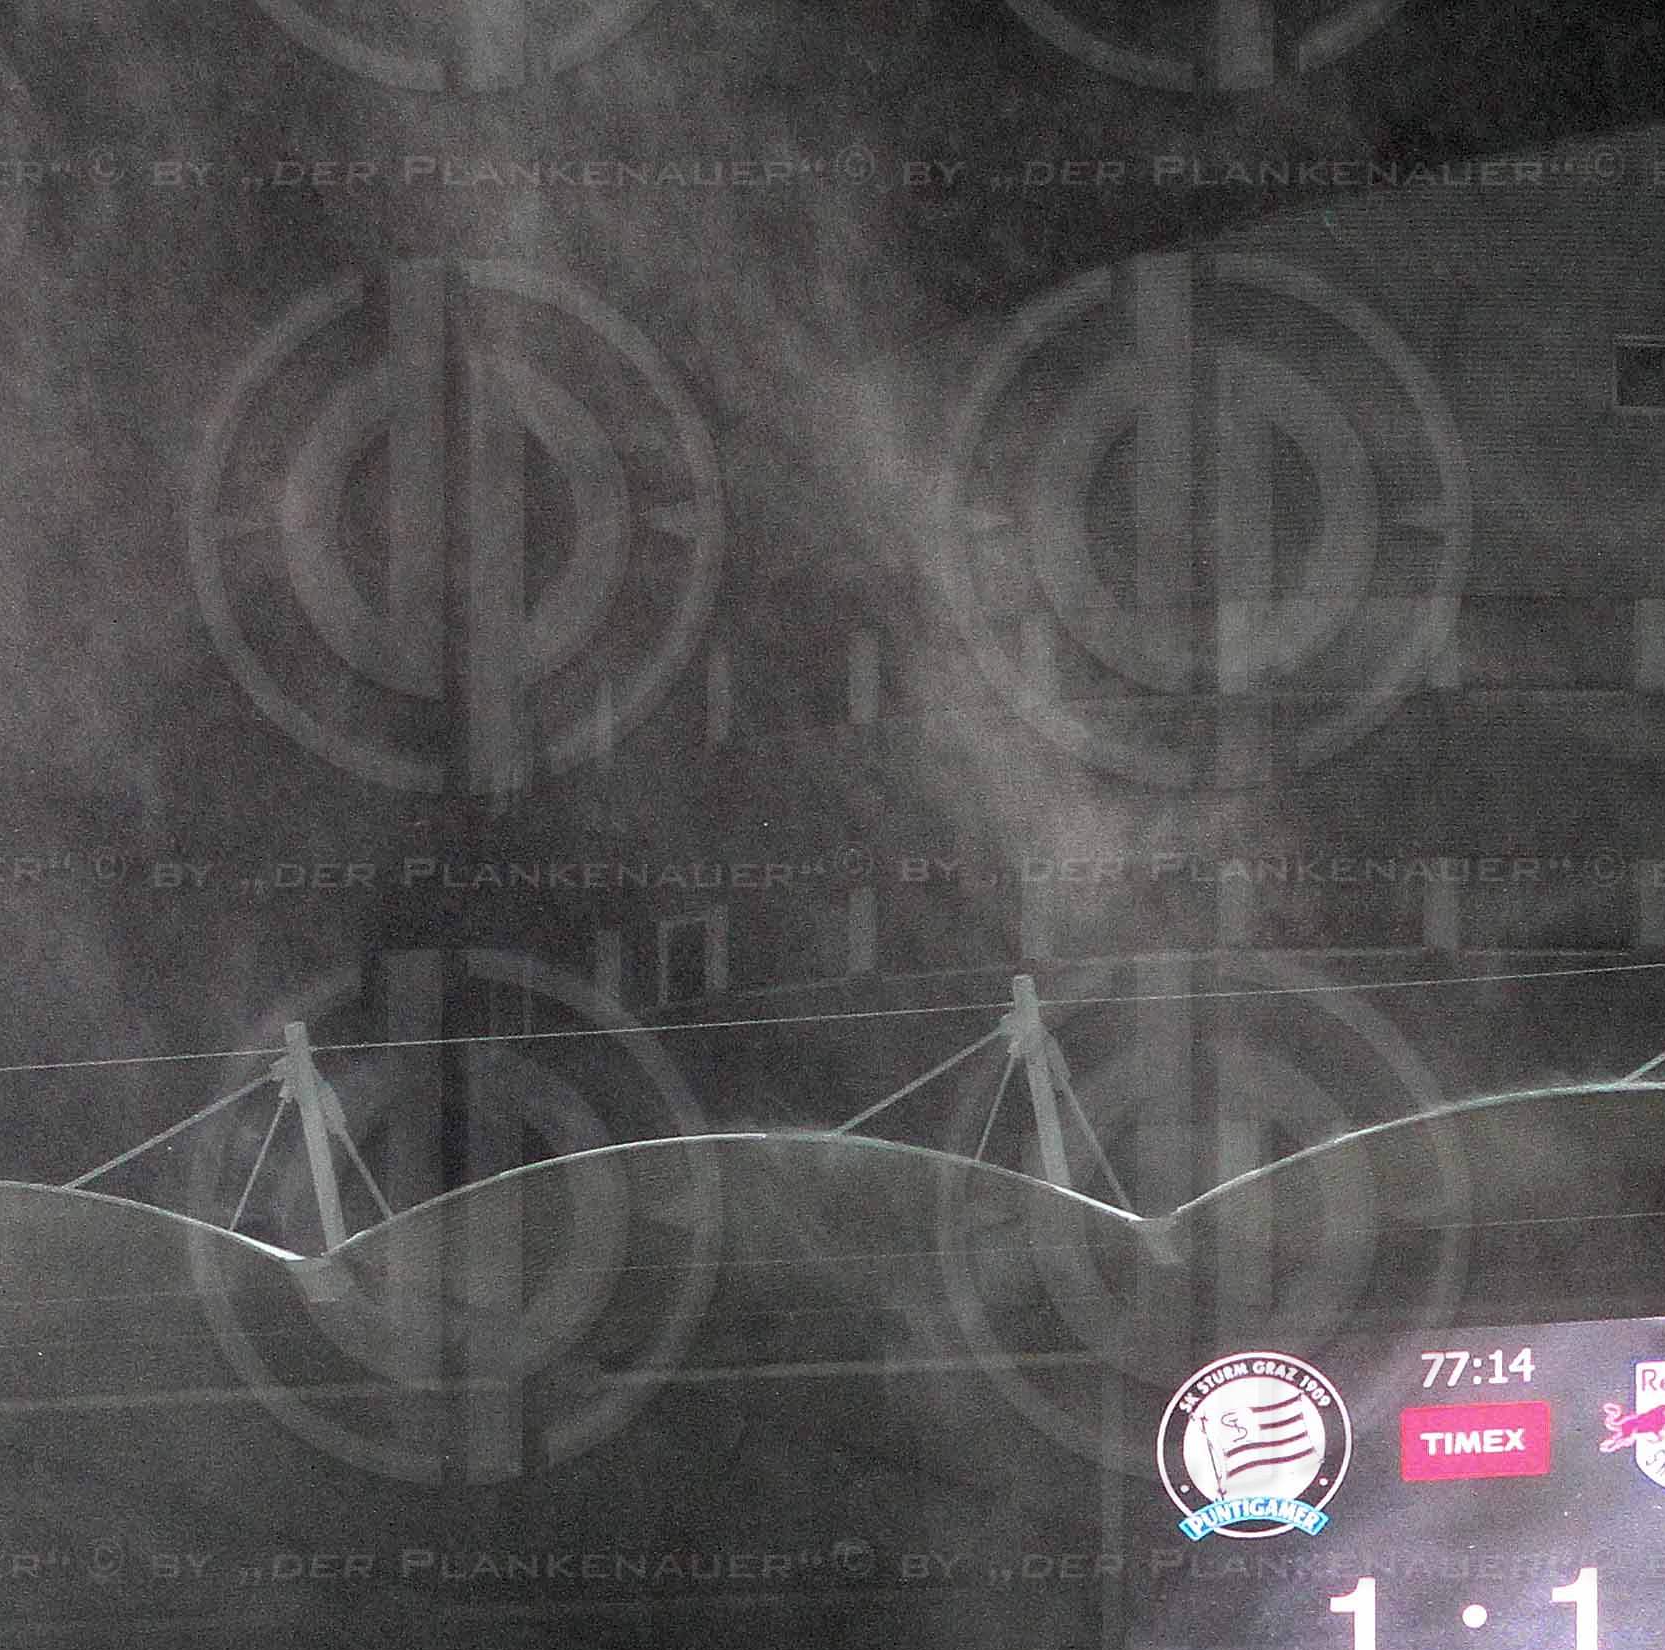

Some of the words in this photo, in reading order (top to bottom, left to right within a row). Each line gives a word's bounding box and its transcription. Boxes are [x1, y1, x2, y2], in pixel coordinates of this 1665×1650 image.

[1179, 1392, 1199, 1413] SK
[1196, 1361, 1248, 1395] STURM
[1252, 1360, 1300, 1384] GRAZ
[1298, 1374, 1332, 1408] 1909
[1421, 1347, 1536, 1388] 77:14
[1420, 1428, 1526, 1456] TIMEX
[1190, 1497, 1321, 1533] PUNTIGAMER
